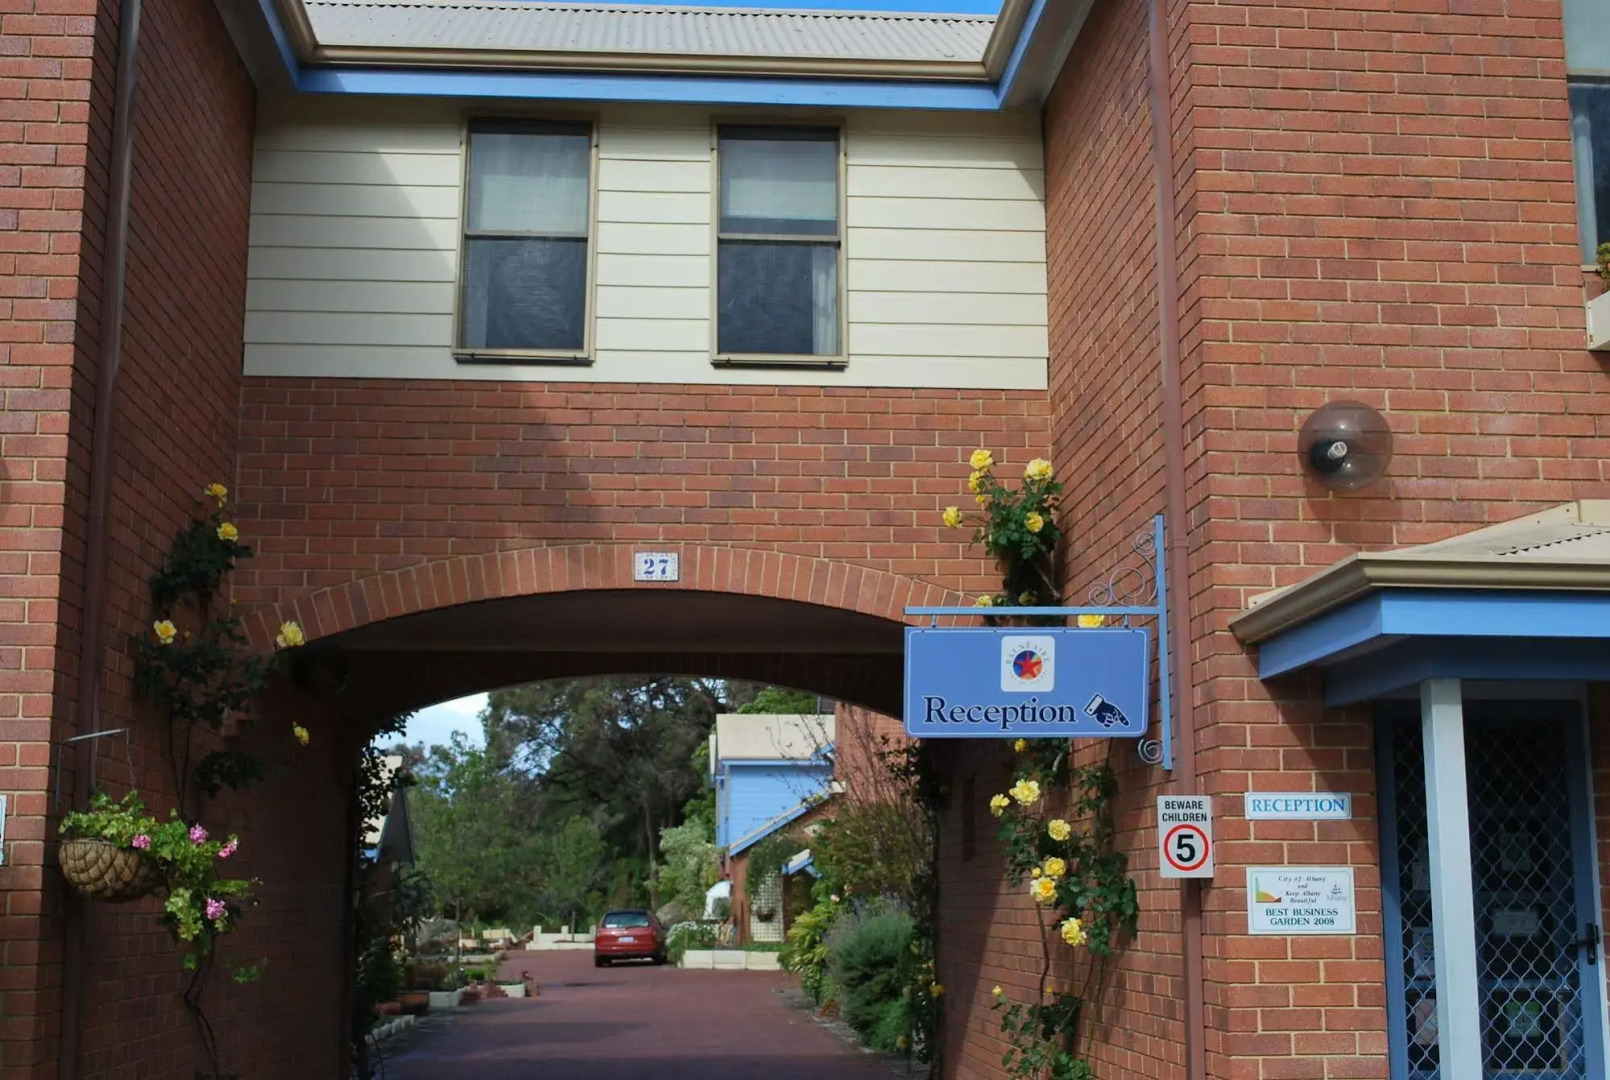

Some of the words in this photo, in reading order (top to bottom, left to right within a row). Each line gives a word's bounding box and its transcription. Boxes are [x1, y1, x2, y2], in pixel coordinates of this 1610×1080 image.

[643, 558, 669, 576] 27
[923, 696, 1076, 730] Reception
[1165, 800, 1203, 810] BEWARE
[1252, 798, 1346, 812] RECEPTION
[1162, 812, 1207, 822] CHILDREN
[1176, 834, 1196, 862] 5
[1265, 908, 1289, 916] BEST
[1292, 908, 1338, 916] BUSINESS
[1270, 917, 1310, 925] GARDEN
[1313, 917, 1335, 925] 2008
